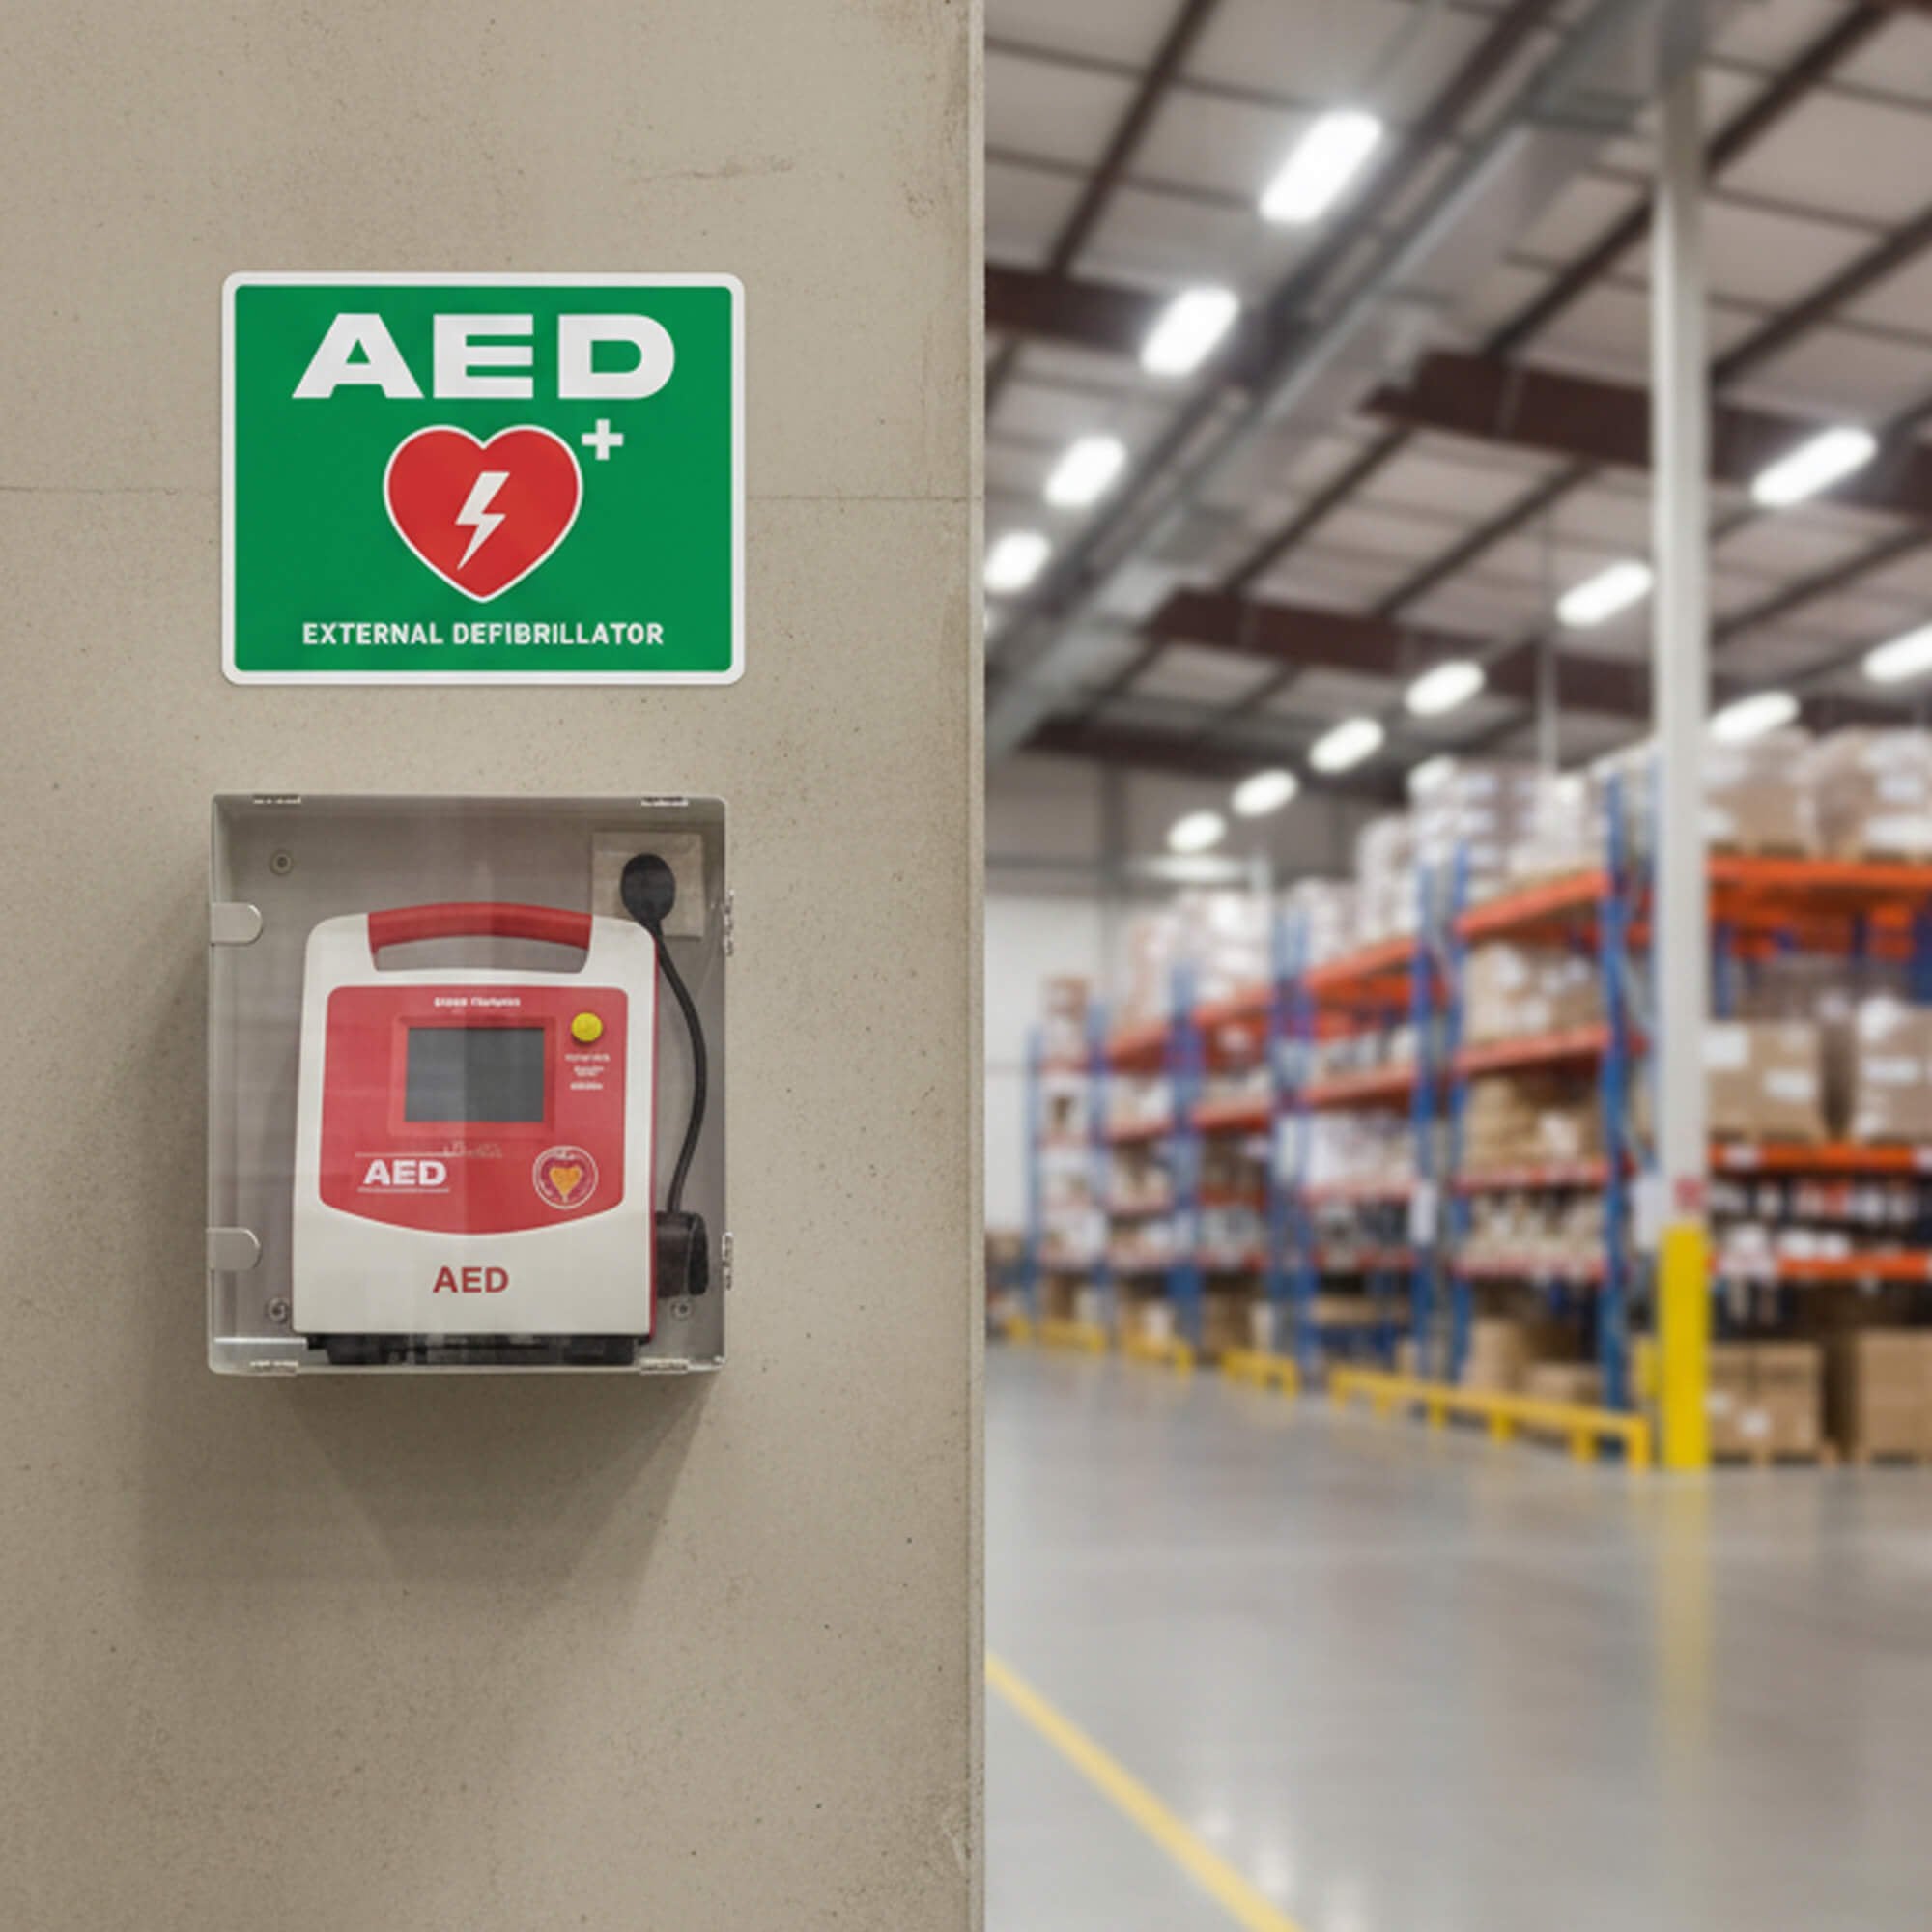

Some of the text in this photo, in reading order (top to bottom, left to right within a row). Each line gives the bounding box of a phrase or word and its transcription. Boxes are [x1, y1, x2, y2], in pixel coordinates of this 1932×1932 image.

[293, 313, 675, 400] AED
[302, 622, 665, 645] EXTERNAL DEFIBRILLATOR
[363, 1158, 447, 1186] AED
[432, 1265, 510, 1293] AED
